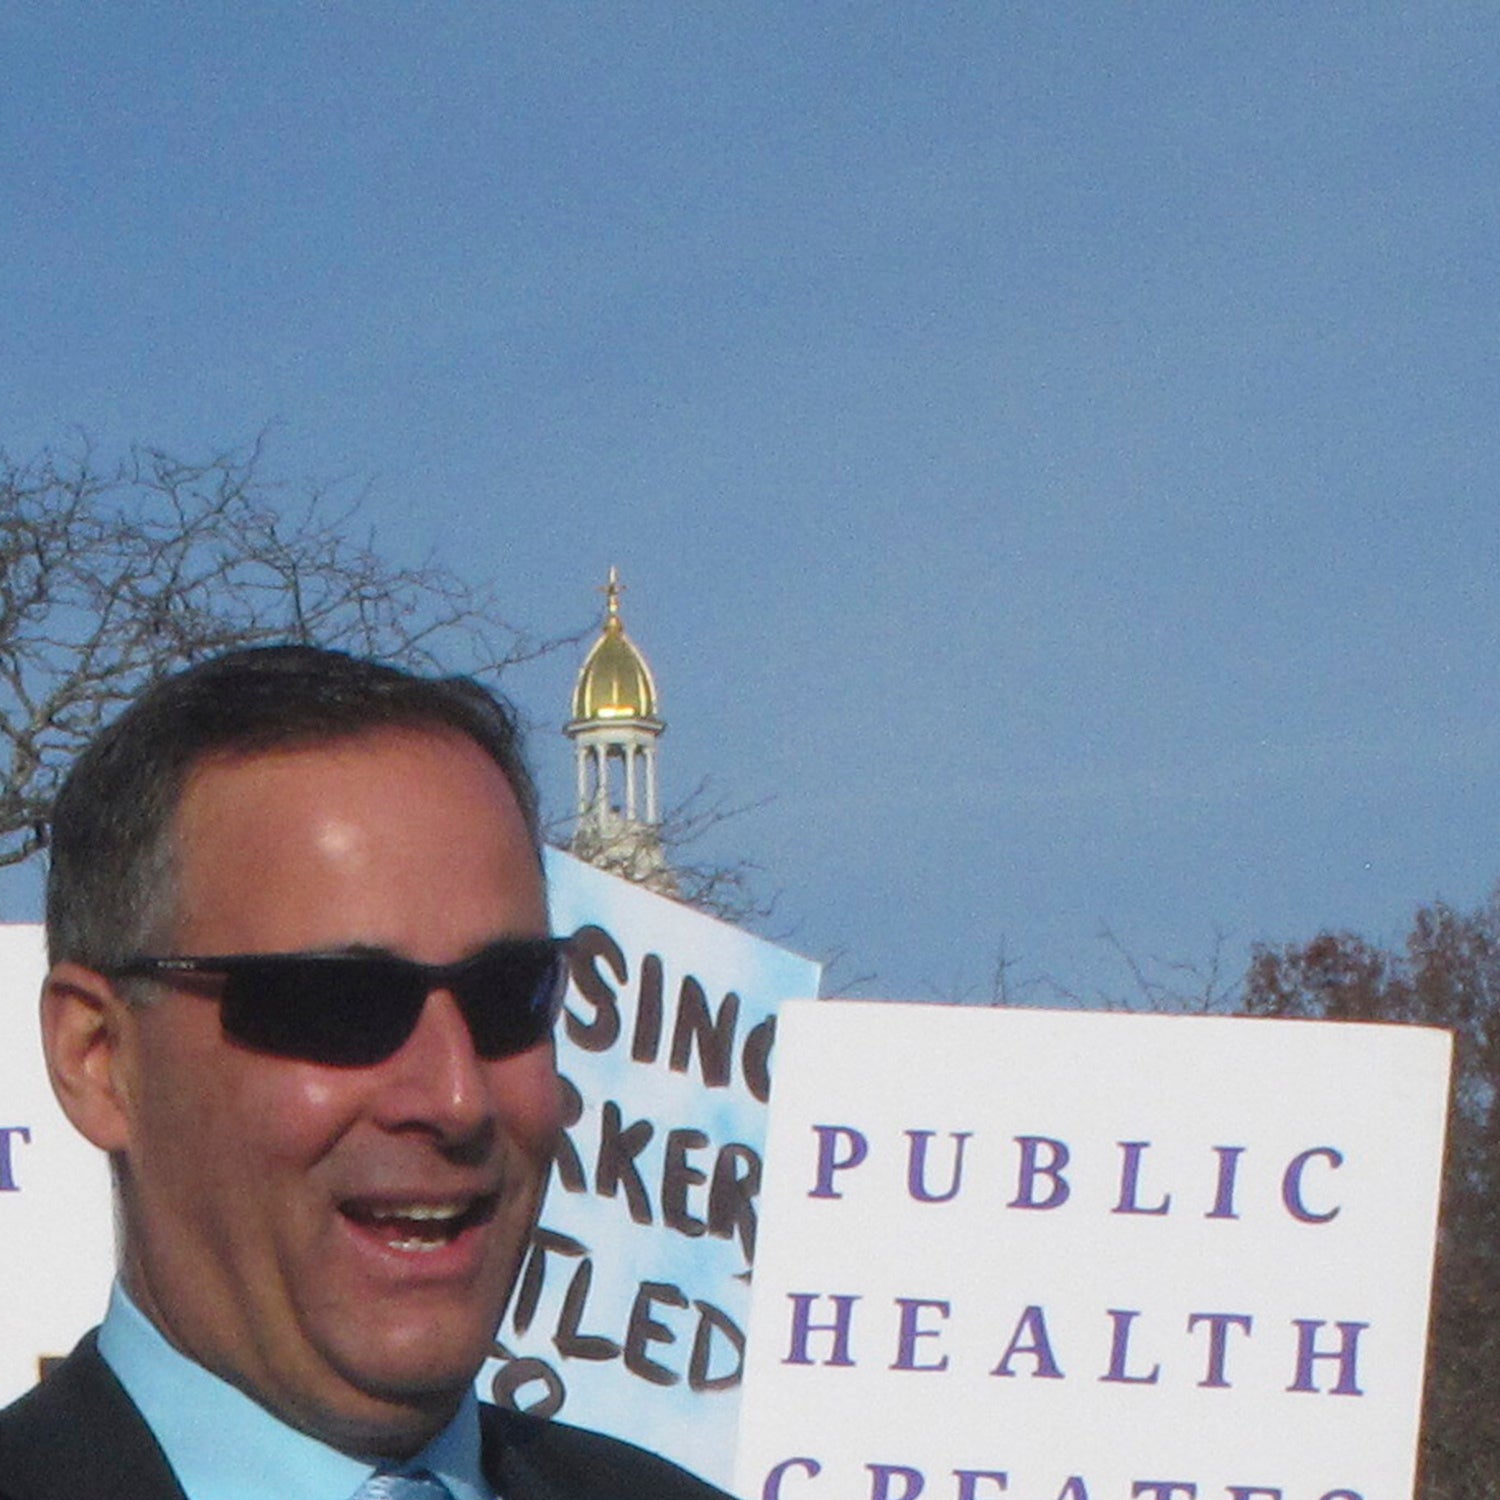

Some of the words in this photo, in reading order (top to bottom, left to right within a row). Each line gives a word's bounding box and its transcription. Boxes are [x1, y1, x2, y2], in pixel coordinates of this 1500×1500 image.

[562, 923, 778, 1103] SIN
[553, 1073, 763, 1284] KER
[807, 1123, 1345, 1226] PUBLIC
[512, 1226, 747, 1393] TLED
[781, 1293, 1370, 1399] HEALTH
